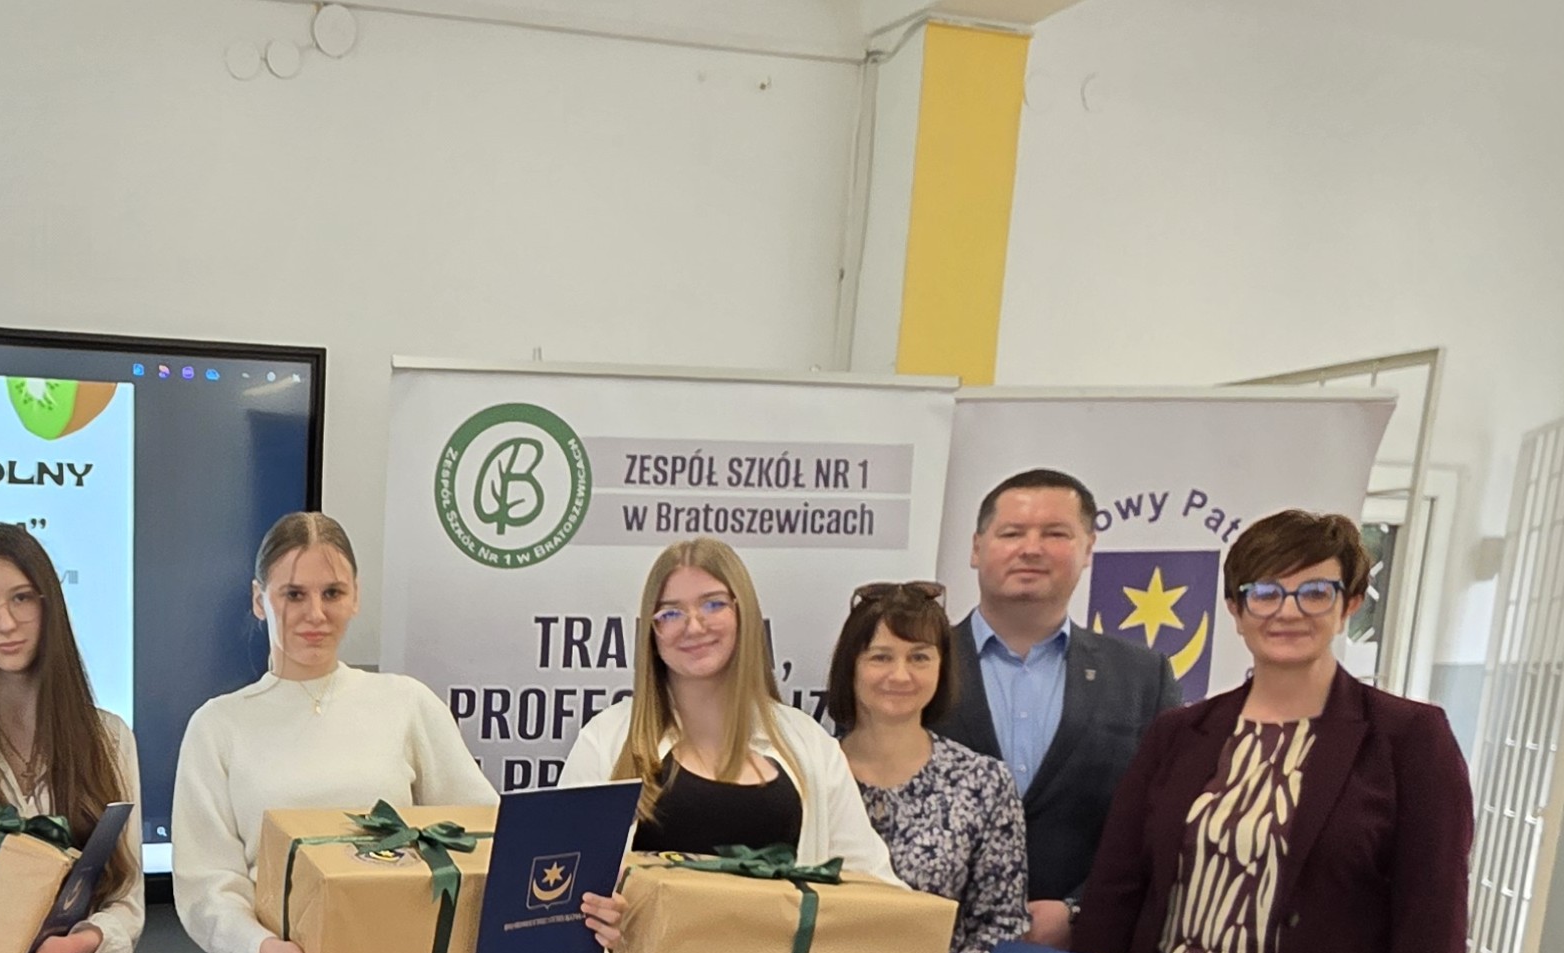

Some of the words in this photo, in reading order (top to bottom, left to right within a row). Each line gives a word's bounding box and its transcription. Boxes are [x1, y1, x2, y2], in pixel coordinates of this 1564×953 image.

[624, 448, 718, 486] ZESPÓŁ
[727, 450, 806, 489] SZKÓŁ
[814, 458, 850, 489] NR
[857, 459, 869, 490] 1
[622, 505, 648, 532] w
[656, 501, 874, 535] Bratoszewicach
[503, 554, 512, 566] 1
